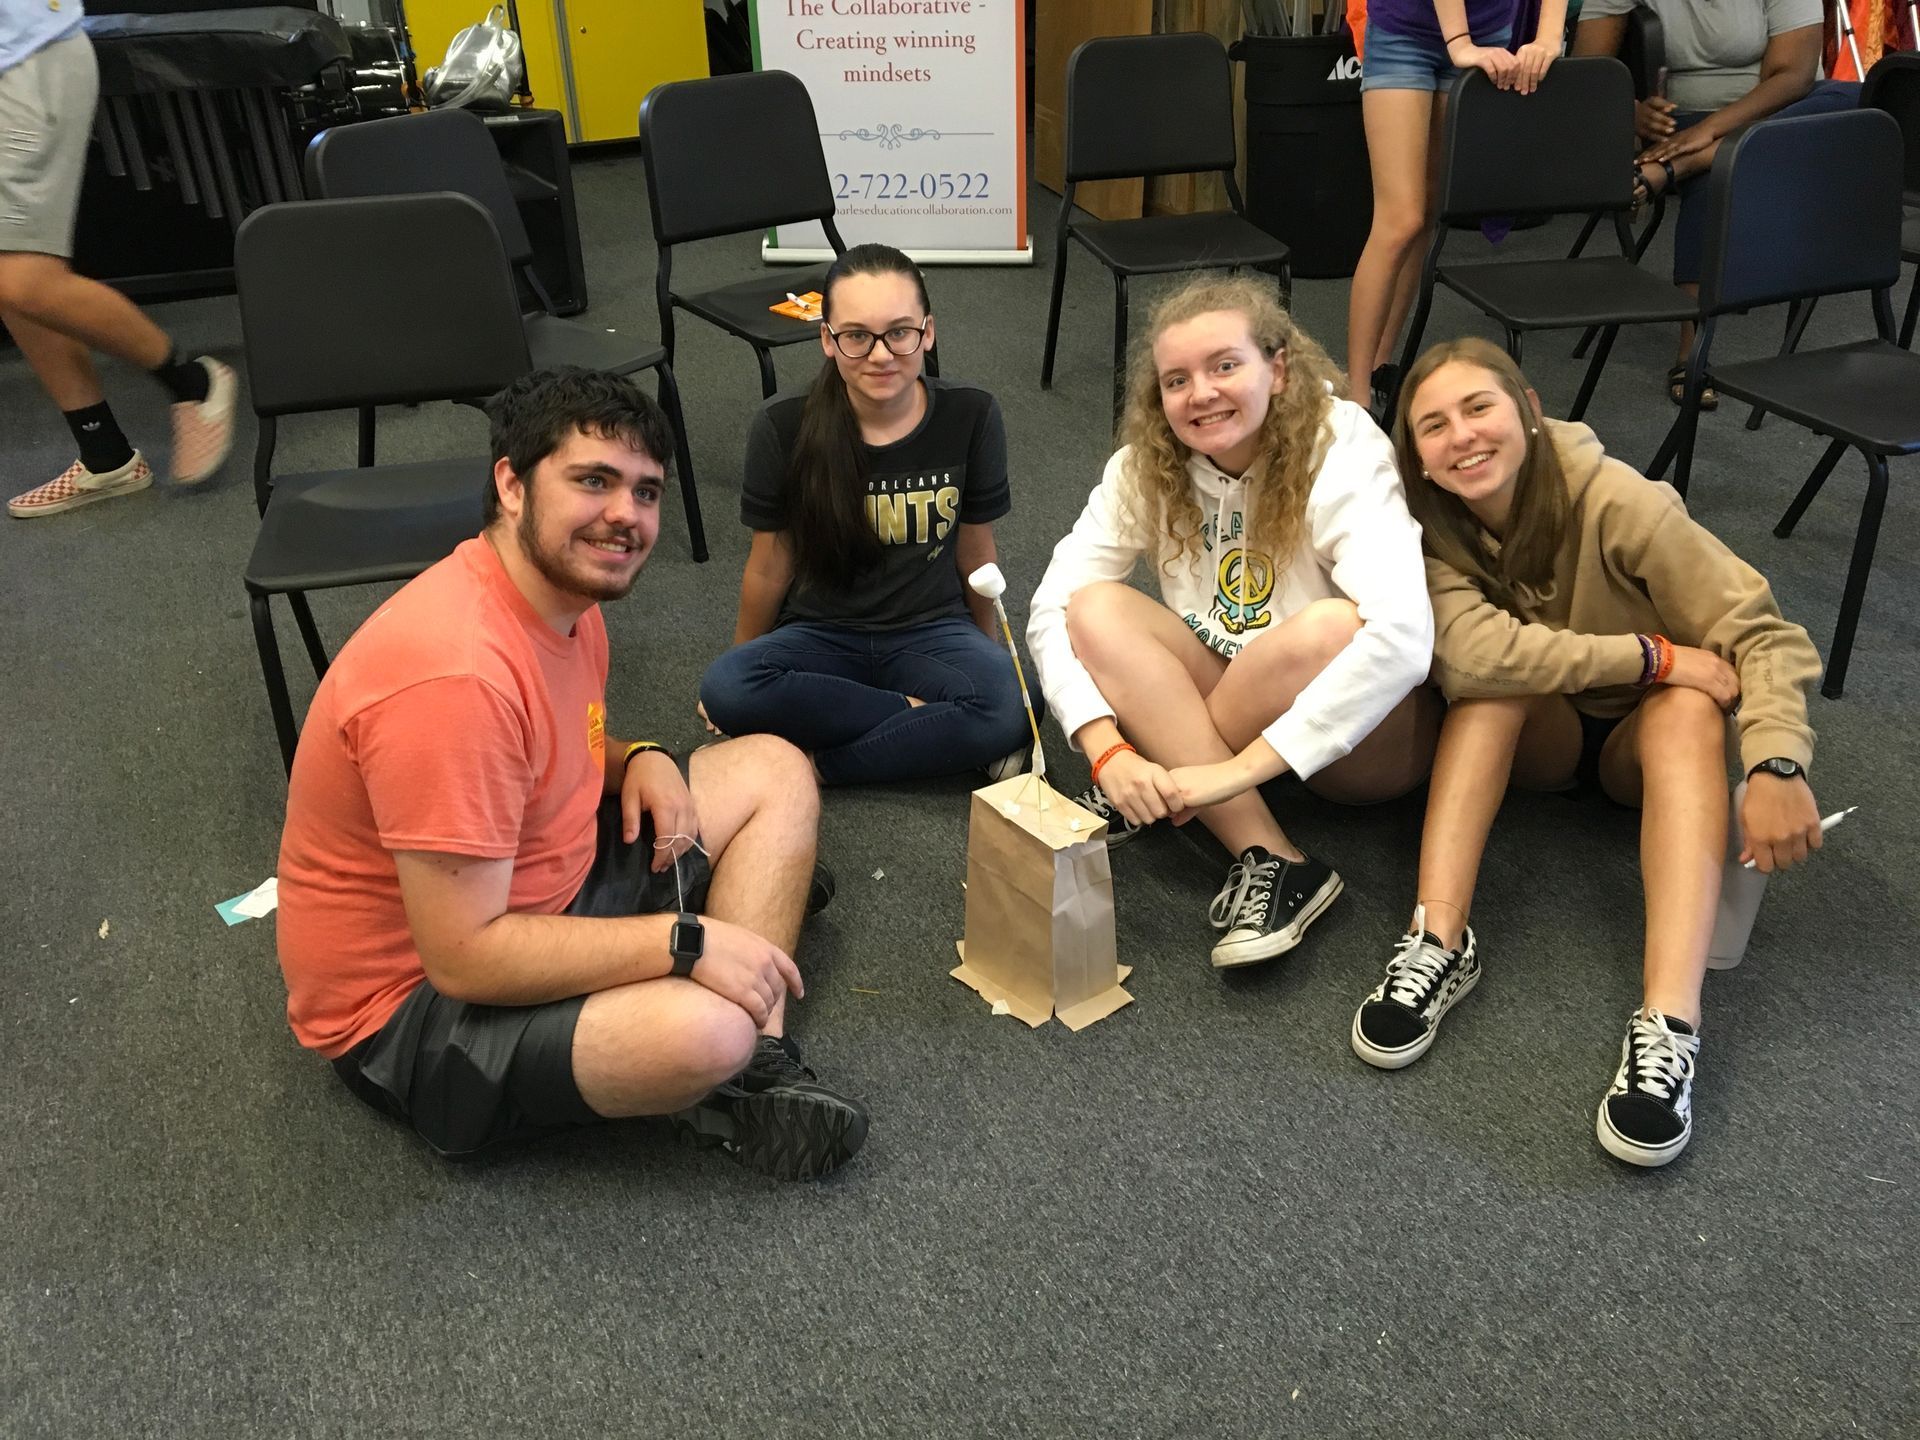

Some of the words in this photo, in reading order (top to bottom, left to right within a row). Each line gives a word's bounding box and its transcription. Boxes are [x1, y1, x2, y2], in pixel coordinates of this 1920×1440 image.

[787, 0, 824, 16] The
[832, 0, 971, 16] Collaborative
[796, 29, 887, 55] Creating
[894, 30, 976, 54] winning
[843, 62, 931, 82] mindsets
[1326, 54, 1364, 80] AC
[834, 172, 989, 199] 2-722-0522
[868, 473, 950, 491] ORLEANS
[864, 486, 960, 545] INTS
[1200, 511, 1243, 552] PEA
[1183, 613, 1243, 657] MOVE
